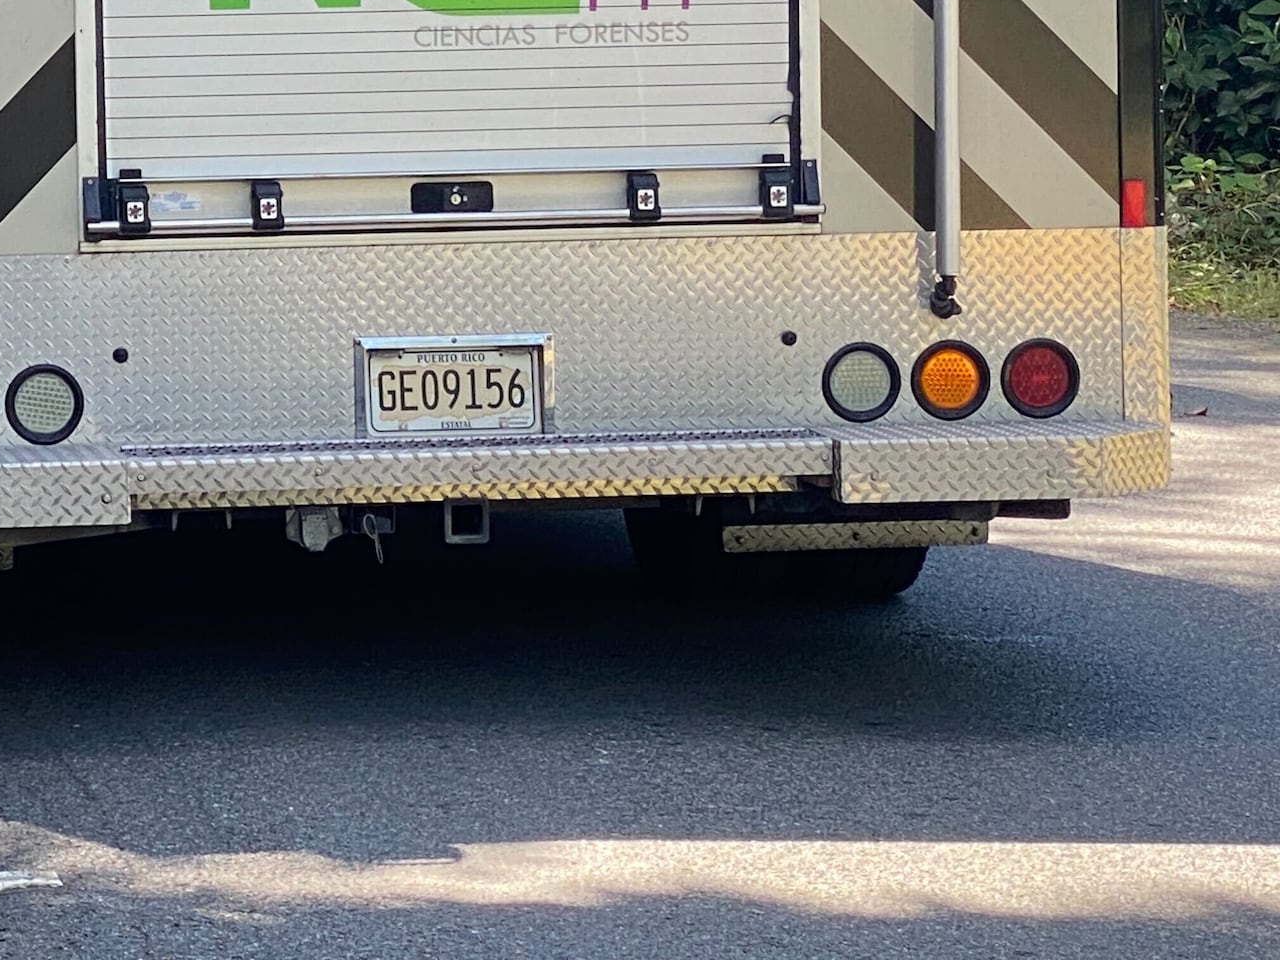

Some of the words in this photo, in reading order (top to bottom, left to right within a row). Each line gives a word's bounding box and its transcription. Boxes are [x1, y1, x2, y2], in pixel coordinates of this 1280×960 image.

[413, 24, 536, 47] CIENCIAS
[555, 21, 690, 44] FORENSES
[417, 353, 458, 363] PUERTO
[461, 352, 486, 362] RICO
[378, 368, 525, 411] GE09156
